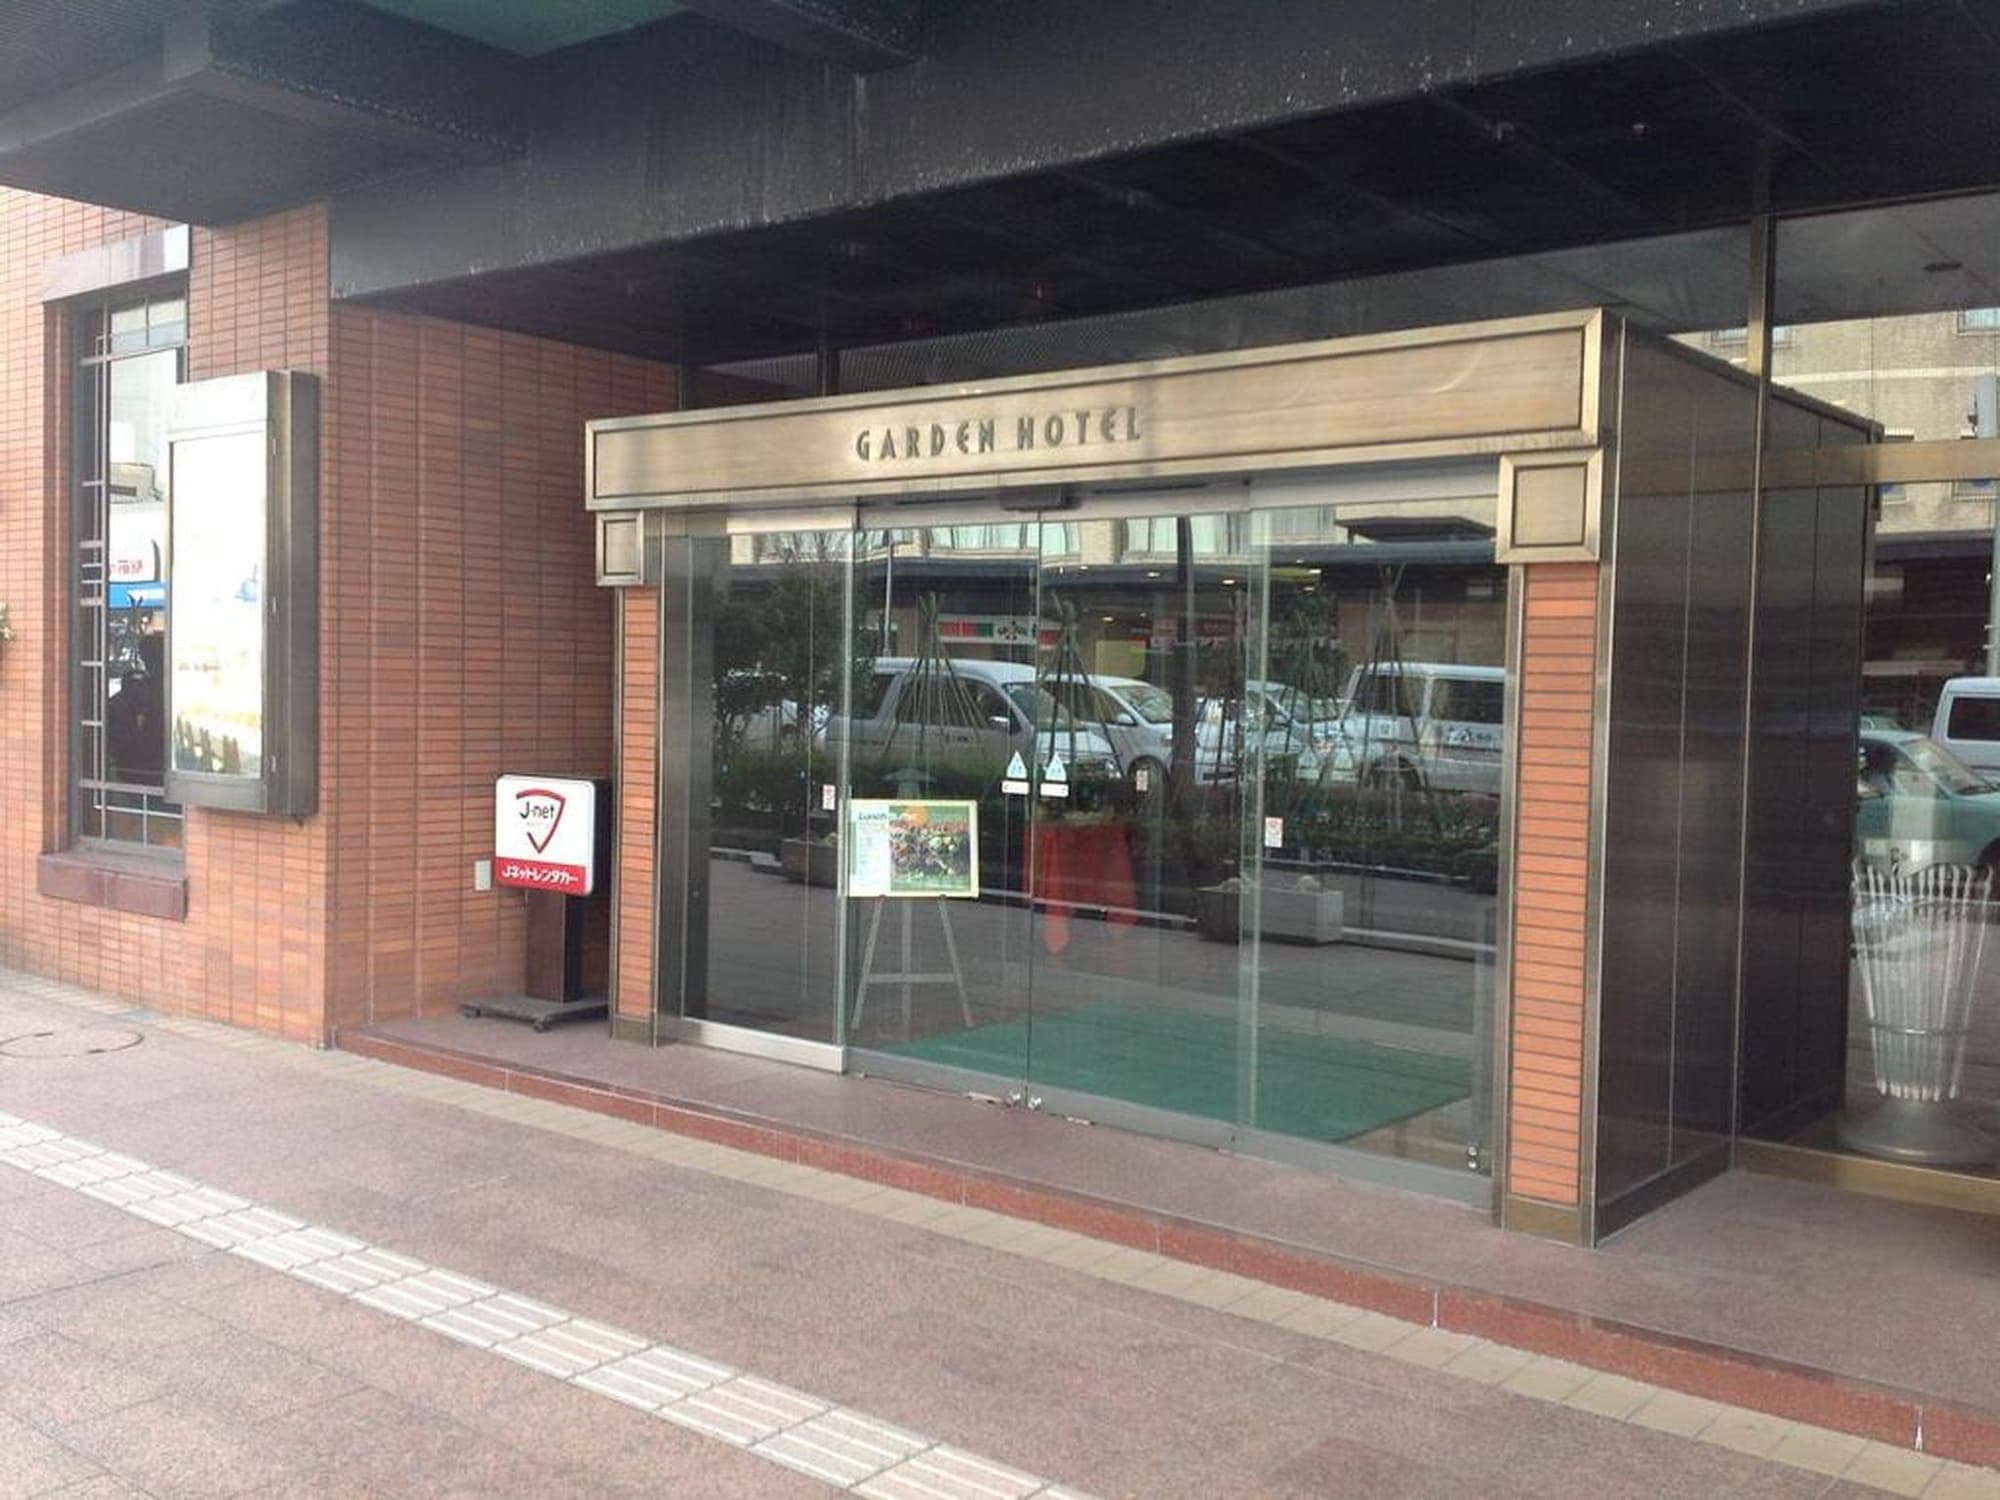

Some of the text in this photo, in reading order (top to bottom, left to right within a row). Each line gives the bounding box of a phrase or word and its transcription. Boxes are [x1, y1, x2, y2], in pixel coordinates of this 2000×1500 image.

[856, 407, 1140, 460] GARDEN HOTEL
[502, 865, 578, 884] Jネットレンタカー
